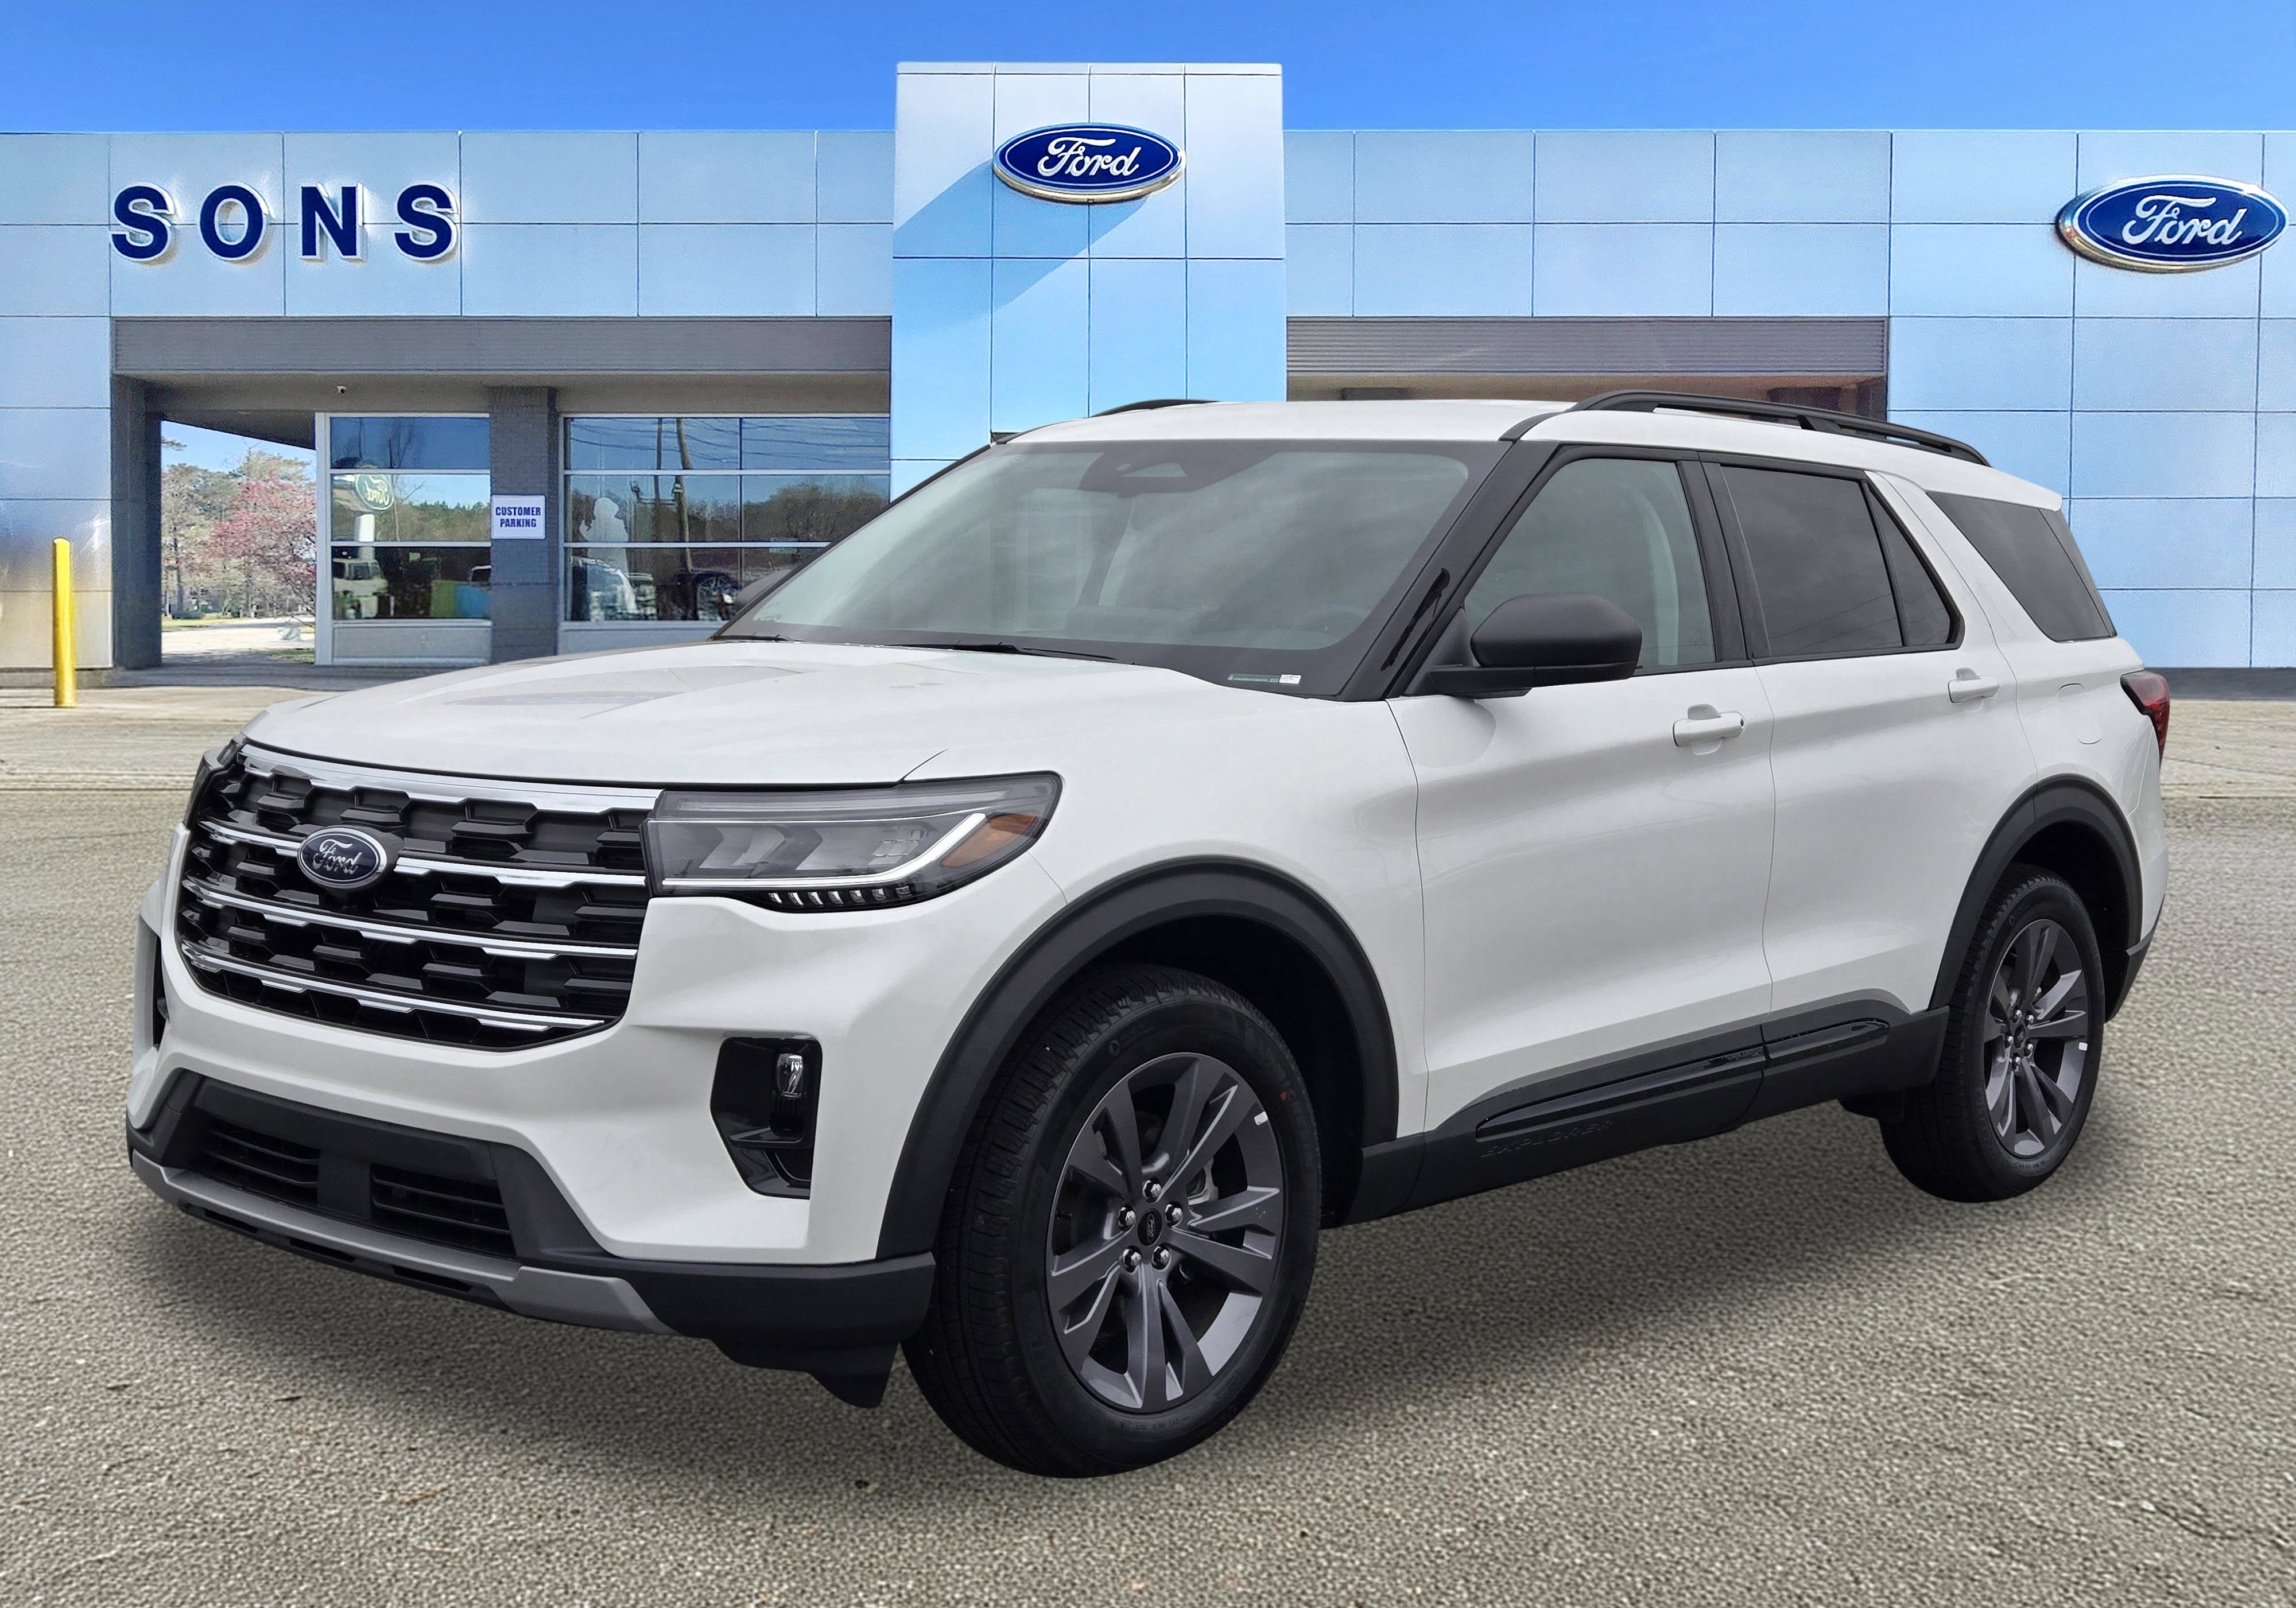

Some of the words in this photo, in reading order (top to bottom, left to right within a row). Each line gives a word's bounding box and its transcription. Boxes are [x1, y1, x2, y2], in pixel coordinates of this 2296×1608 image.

[1037, 136, 1142, 177] Ford
[111, 183, 457, 261] SONS
[2122, 195, 2247, 245] Ford
[495, 506, 541, 516] CUSTOMER
[500, 518, 537, 528] PARKING
[312, 838, 363, 875] Ford
